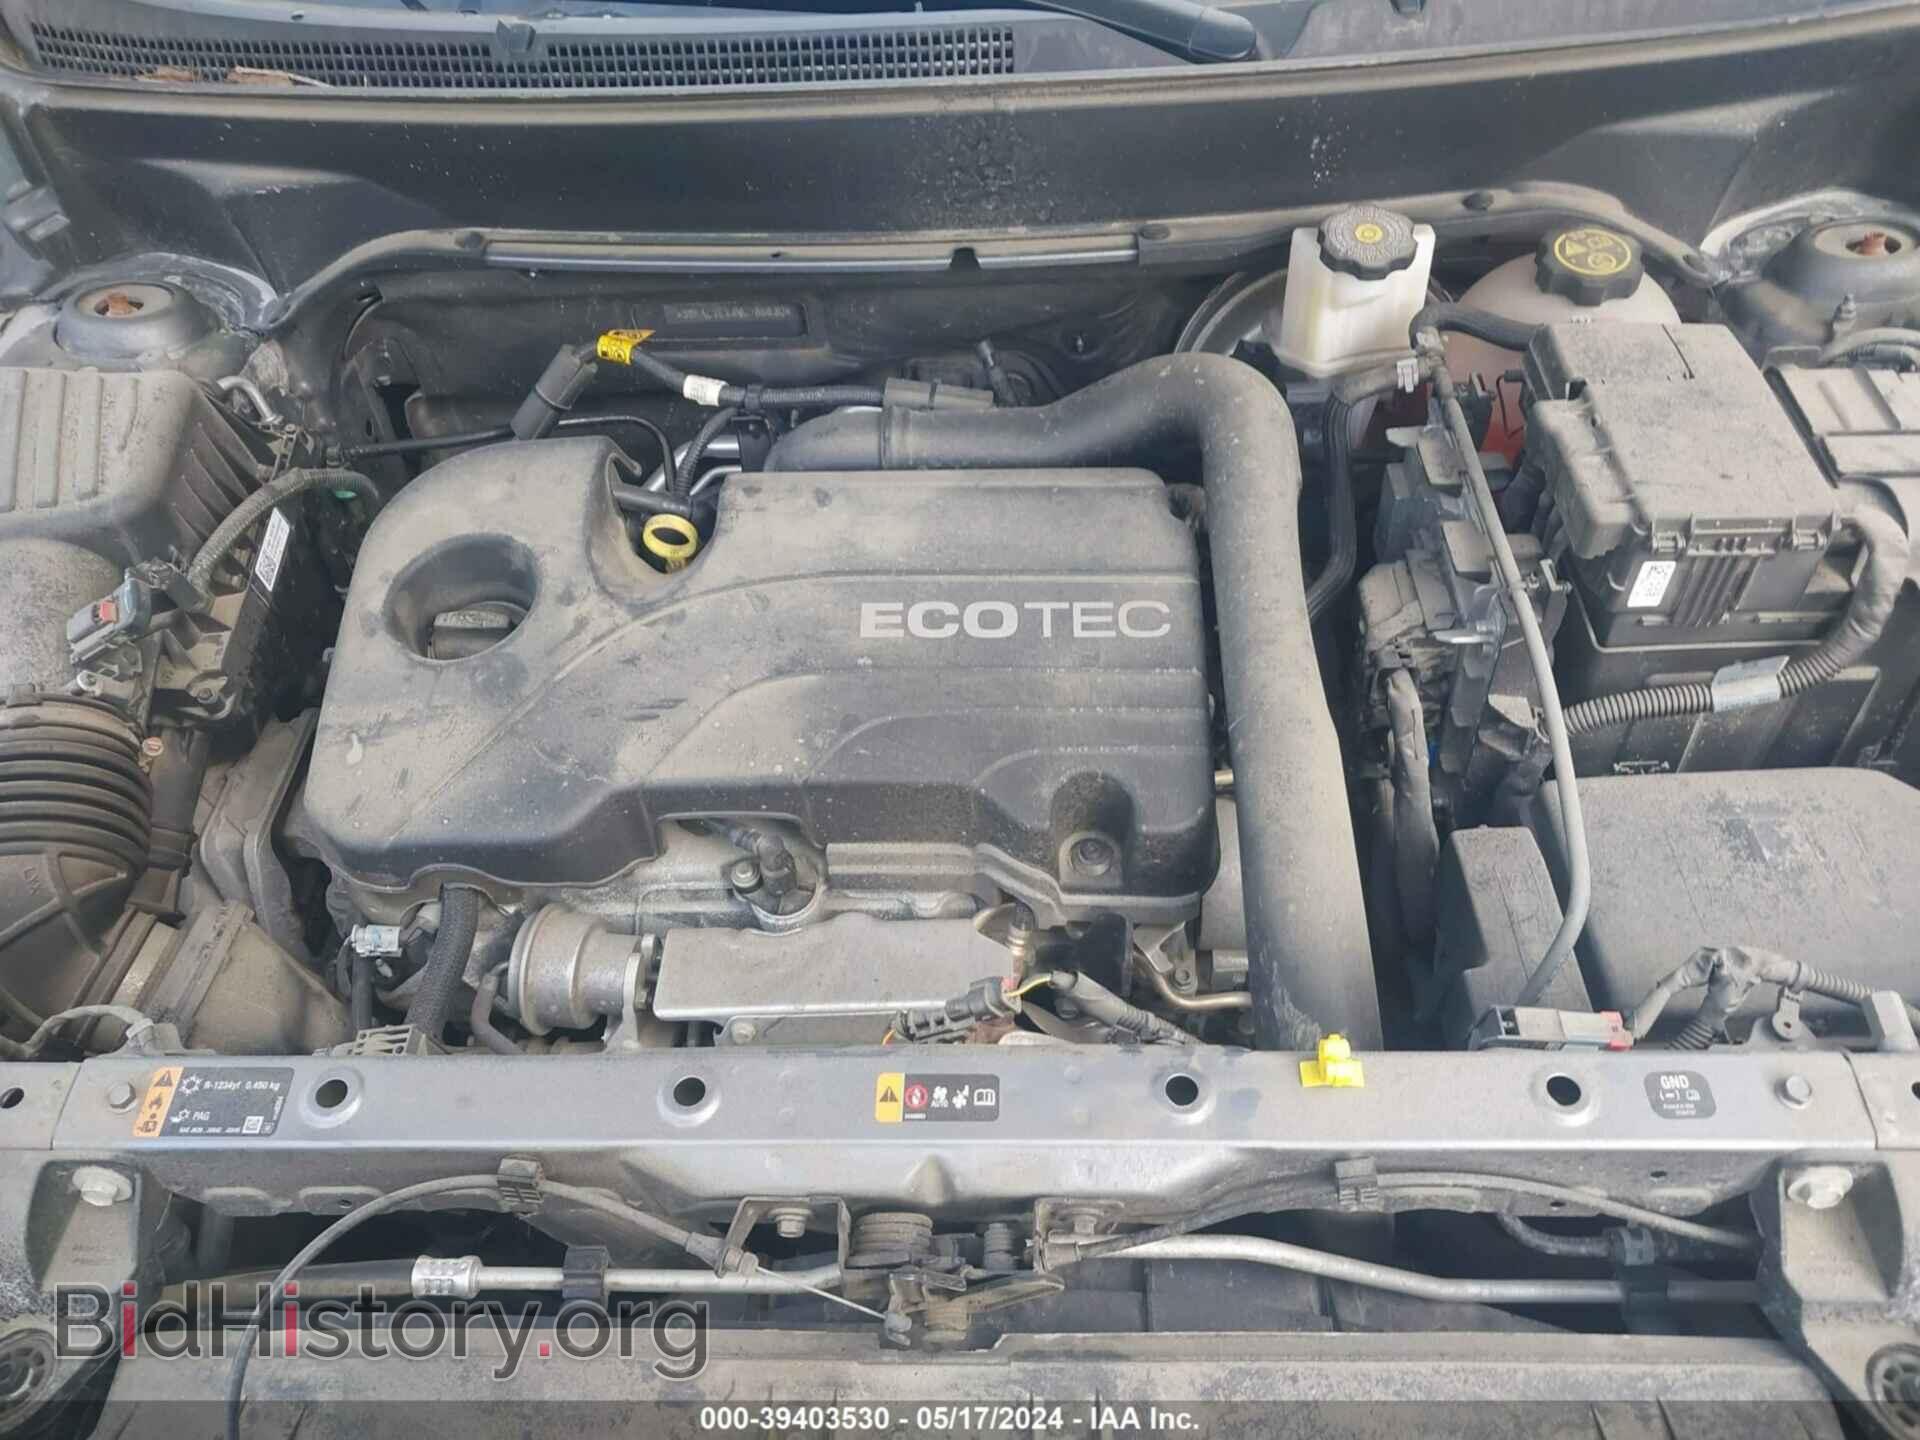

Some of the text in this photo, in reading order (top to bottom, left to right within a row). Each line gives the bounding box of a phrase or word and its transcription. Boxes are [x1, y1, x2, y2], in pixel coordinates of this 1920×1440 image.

[859, 600, 1171, 639] ECOTEC
[1660, 1074, 1689, 1089] GND
[192, 1111, 210, 1121] PAG
